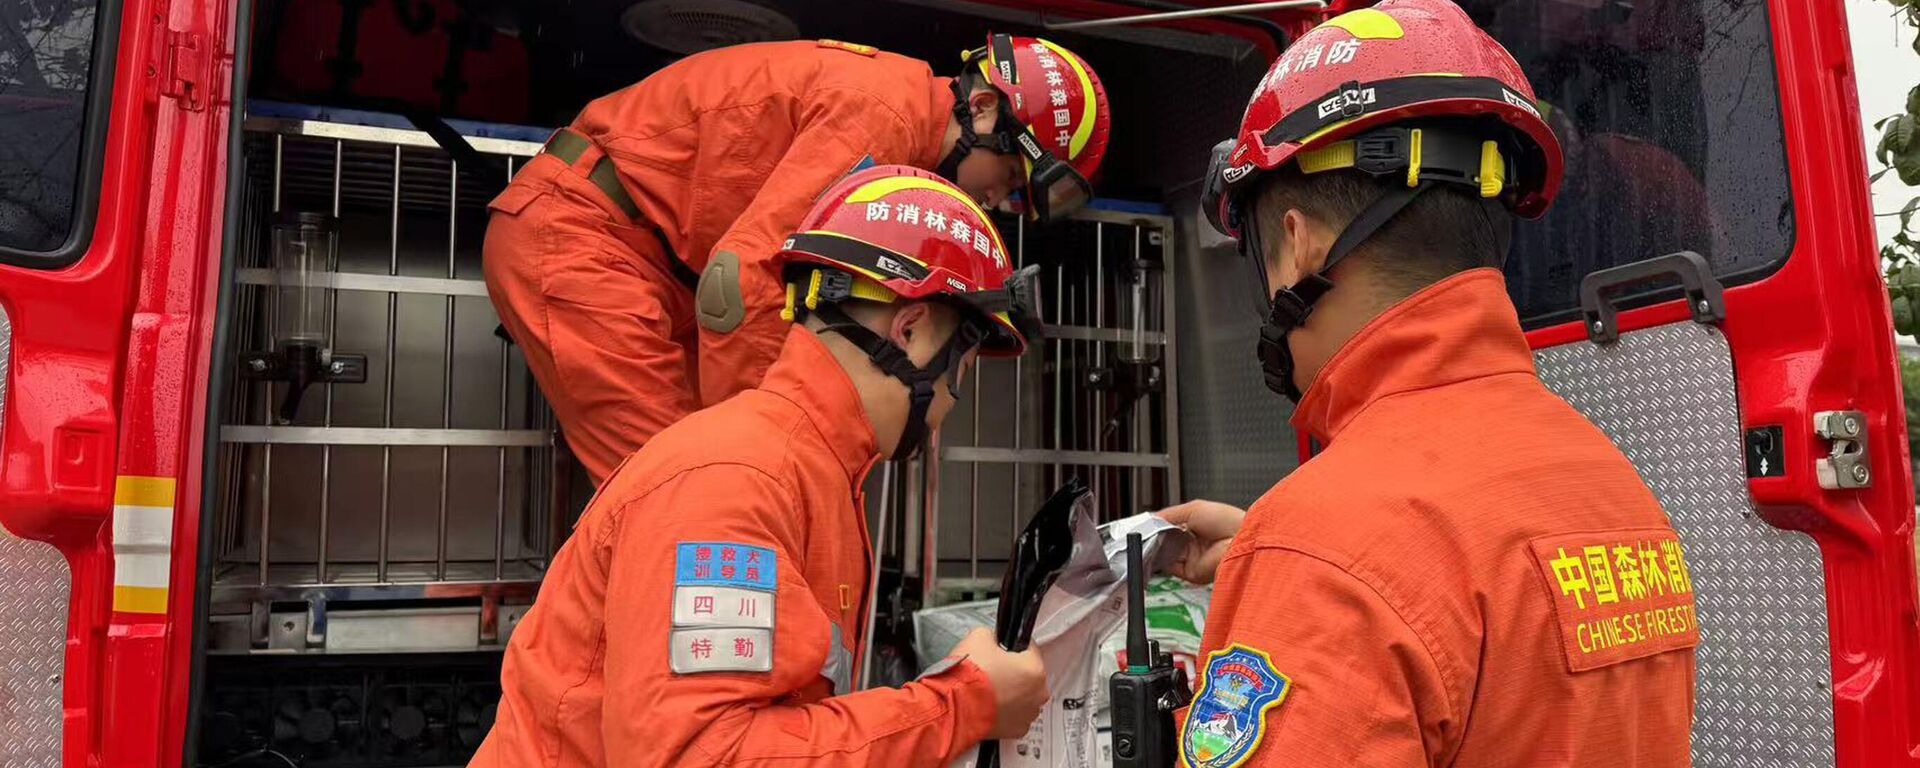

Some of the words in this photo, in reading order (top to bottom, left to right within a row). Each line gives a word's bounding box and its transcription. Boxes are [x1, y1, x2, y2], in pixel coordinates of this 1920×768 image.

[693, 596, 757, 618] 四川
[1577, 613, 1647, 654] CHINESE
[690, 637, 755, 660] 特勤
